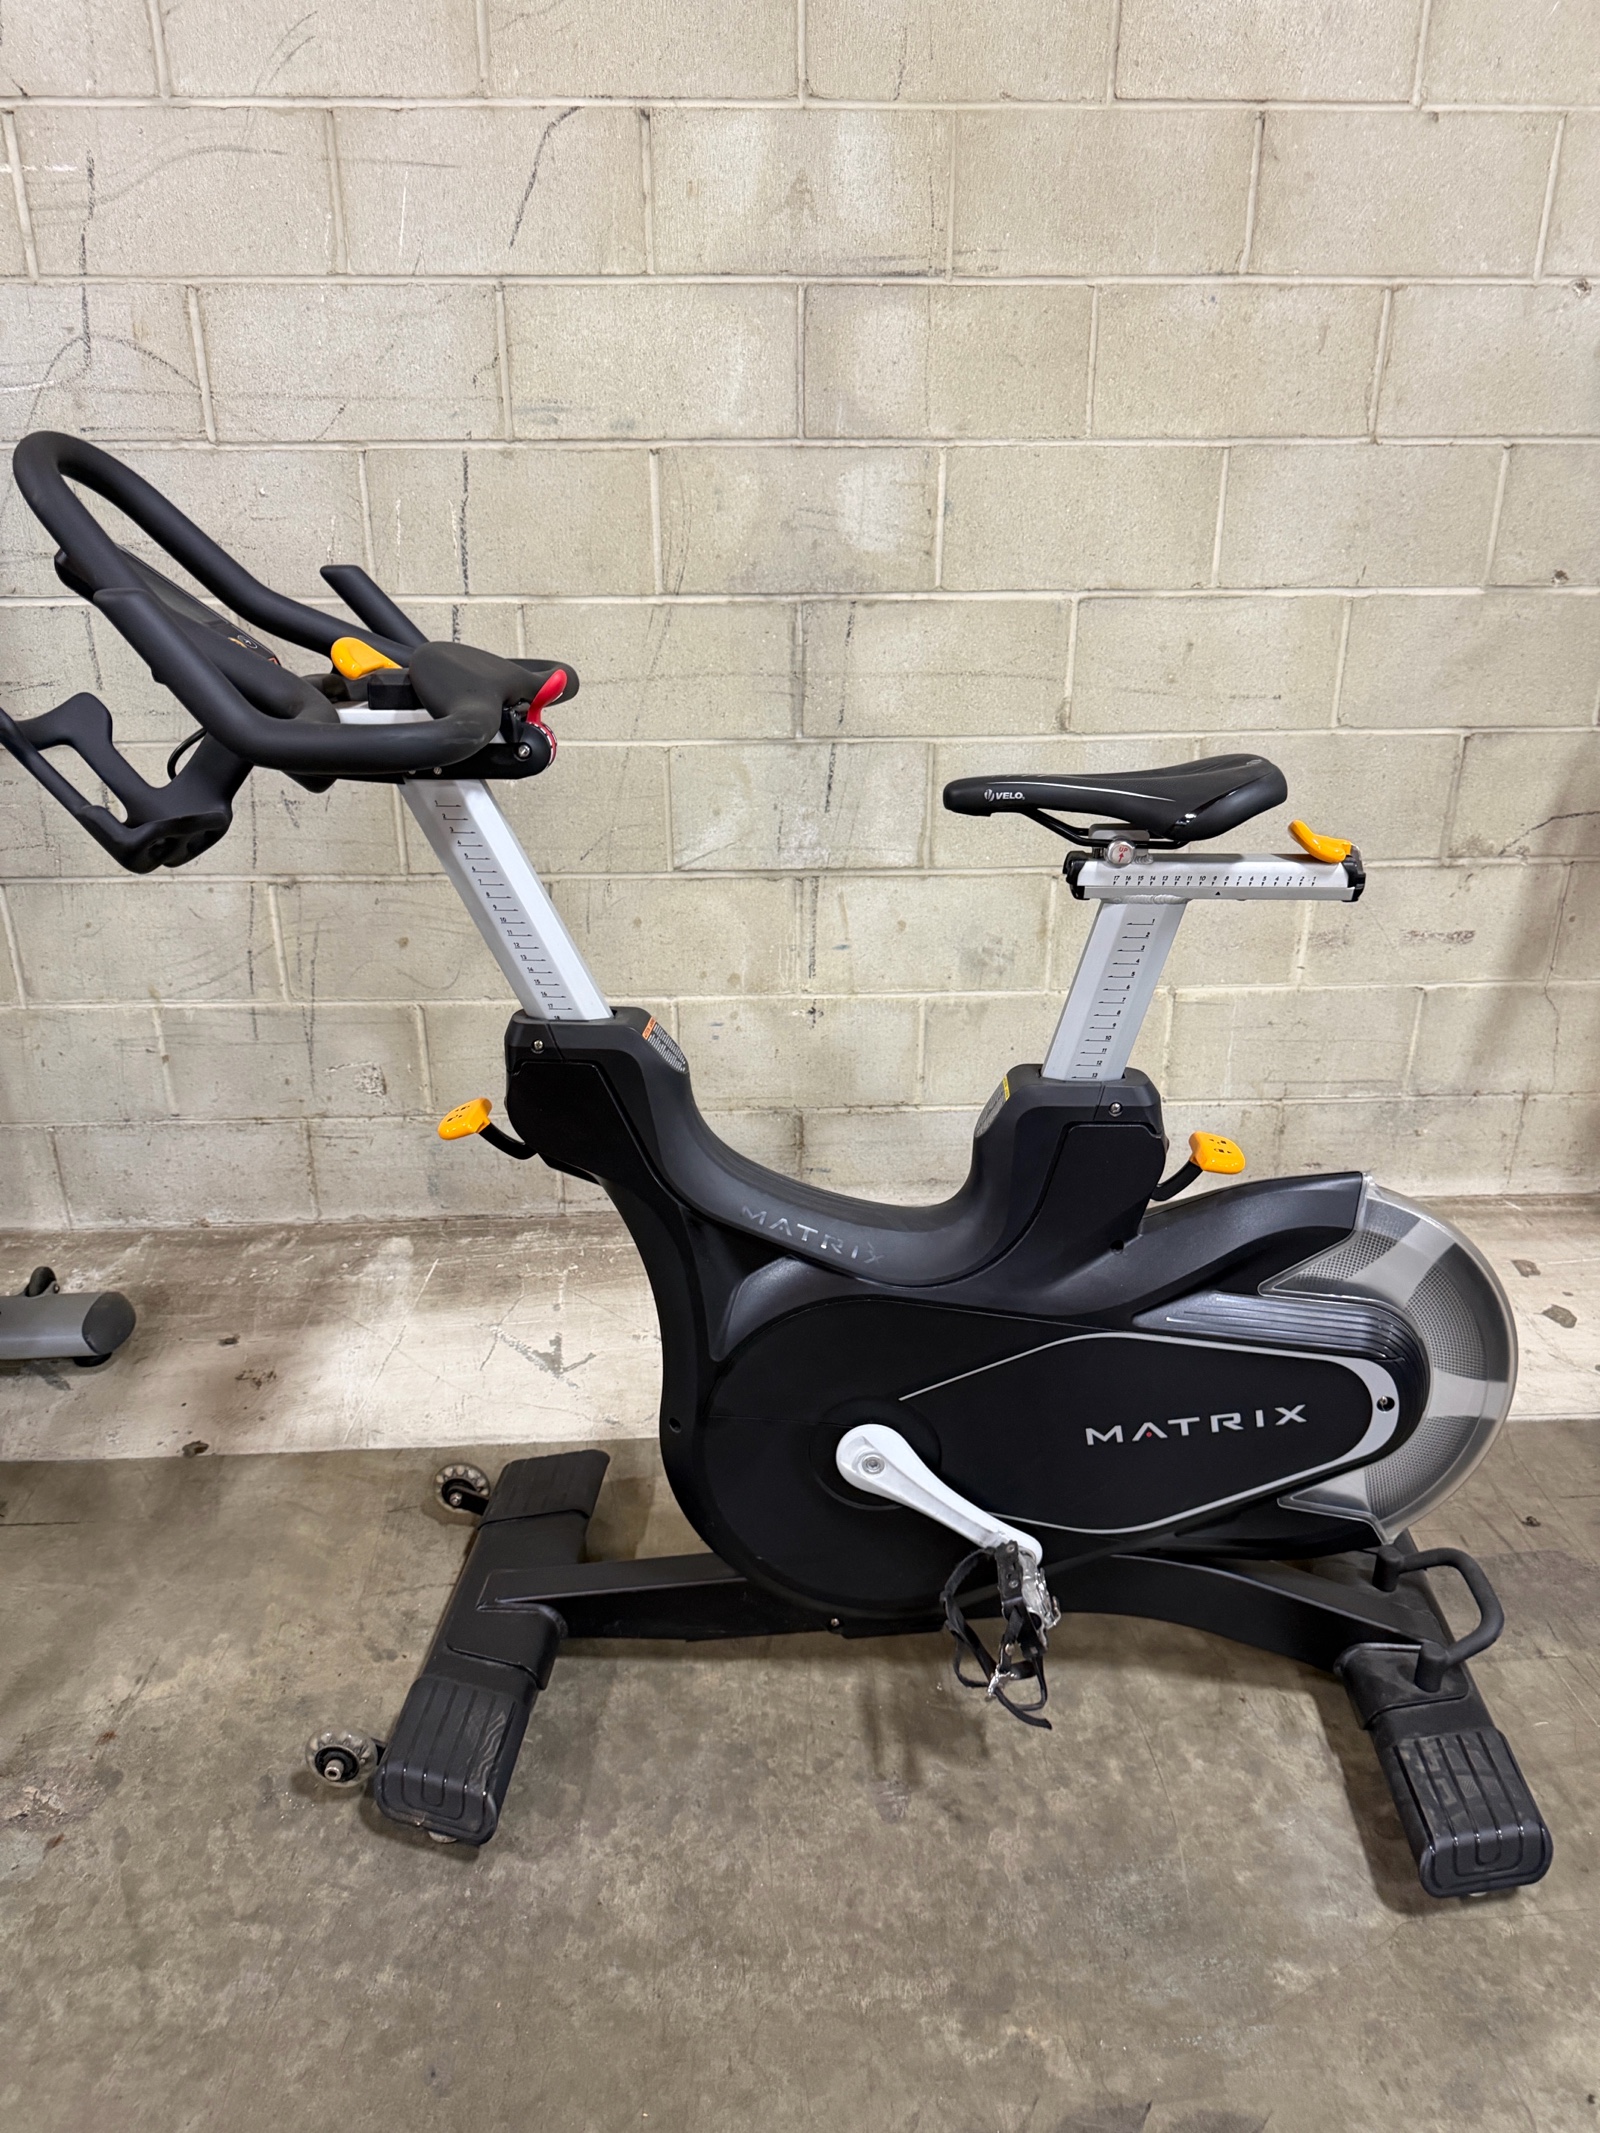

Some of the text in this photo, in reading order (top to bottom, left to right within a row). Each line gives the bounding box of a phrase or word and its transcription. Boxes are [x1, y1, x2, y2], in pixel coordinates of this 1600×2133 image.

[995, 791, 1024, 800] VELO
[741, 1204, 885, 1265] MATRIX
[1085, 1403, 1308, 1446] MATRIX
